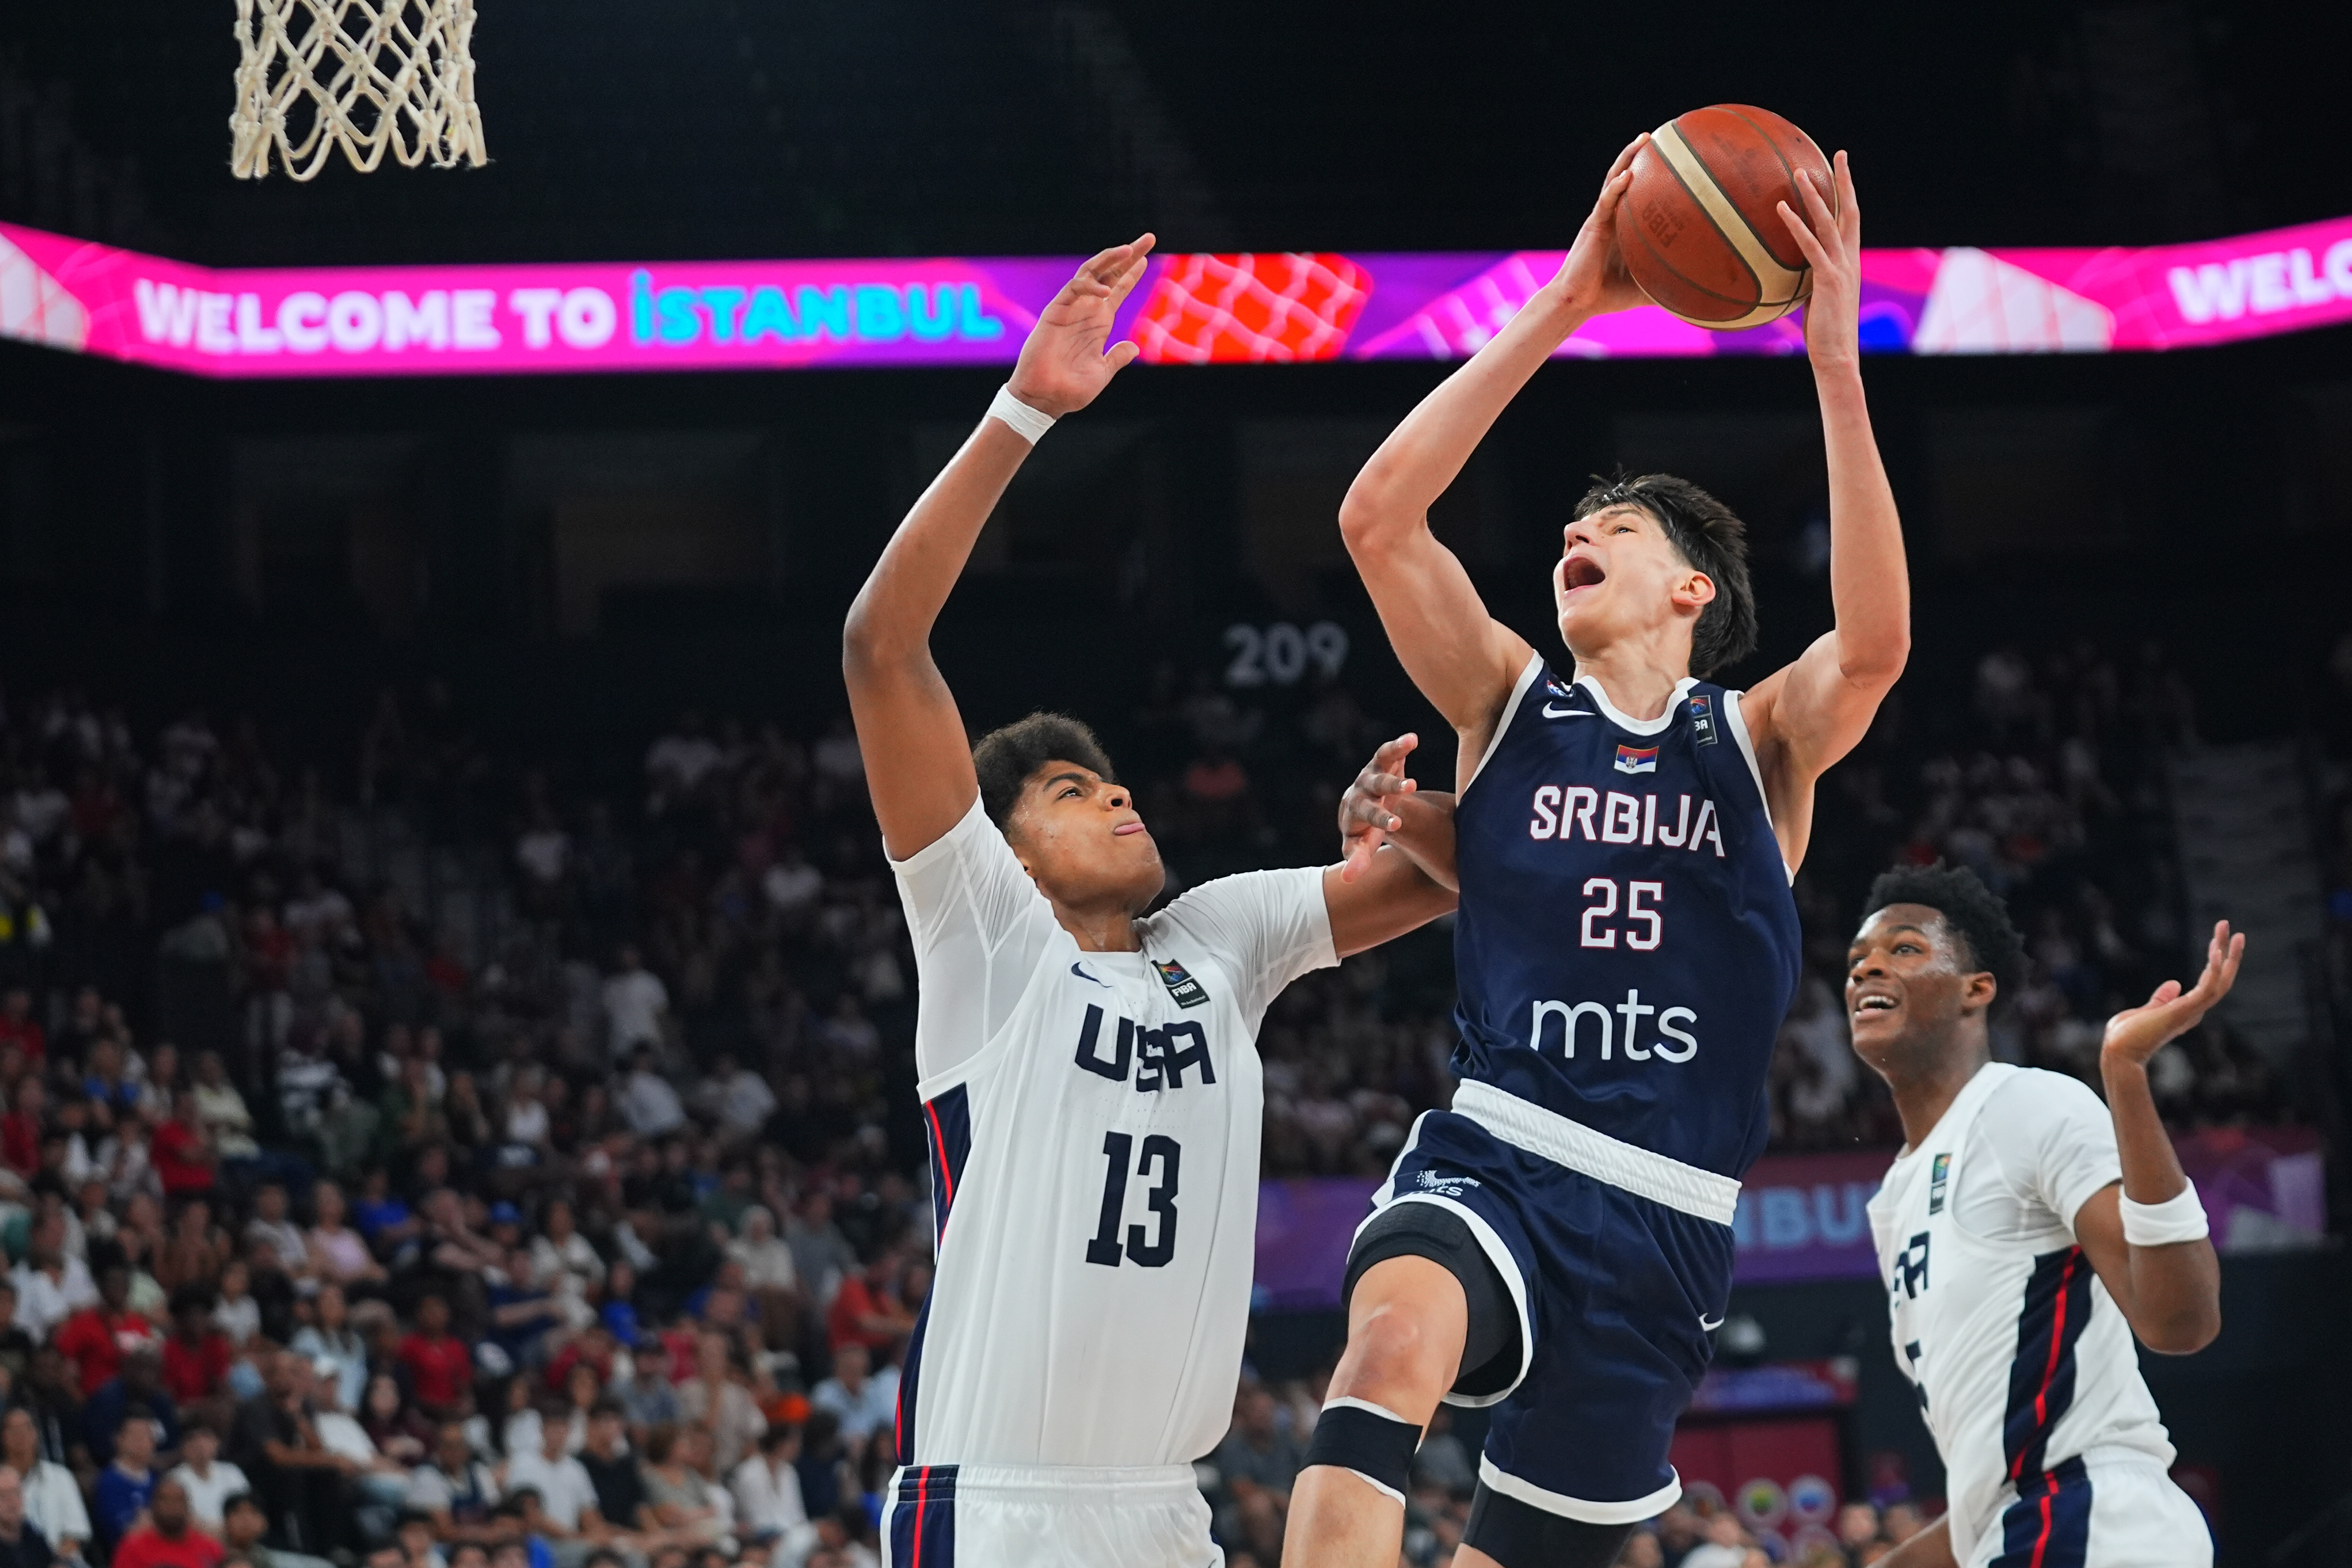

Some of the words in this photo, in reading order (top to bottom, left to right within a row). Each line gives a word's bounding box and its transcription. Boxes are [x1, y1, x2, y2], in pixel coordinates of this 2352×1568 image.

[135, 277, 501, 353] WELCOME
[509, 286, 617, 350] TO
[630, 268, 1005, 343] İSTANBUL
[1223, 621, 1349, 686] 209
[1695, 719, 1708, 731] BA
[1530, 785, 1725, 857] SRBIJA
[1580, 877, 1663, 951] 25
[1171, 982, 1197, 997] FIBA
[1530, 989, 1697, 1063] mts
[1075, 1003, 1216, 1093] USA
[1086, 1130, 1181, 1267] 13
